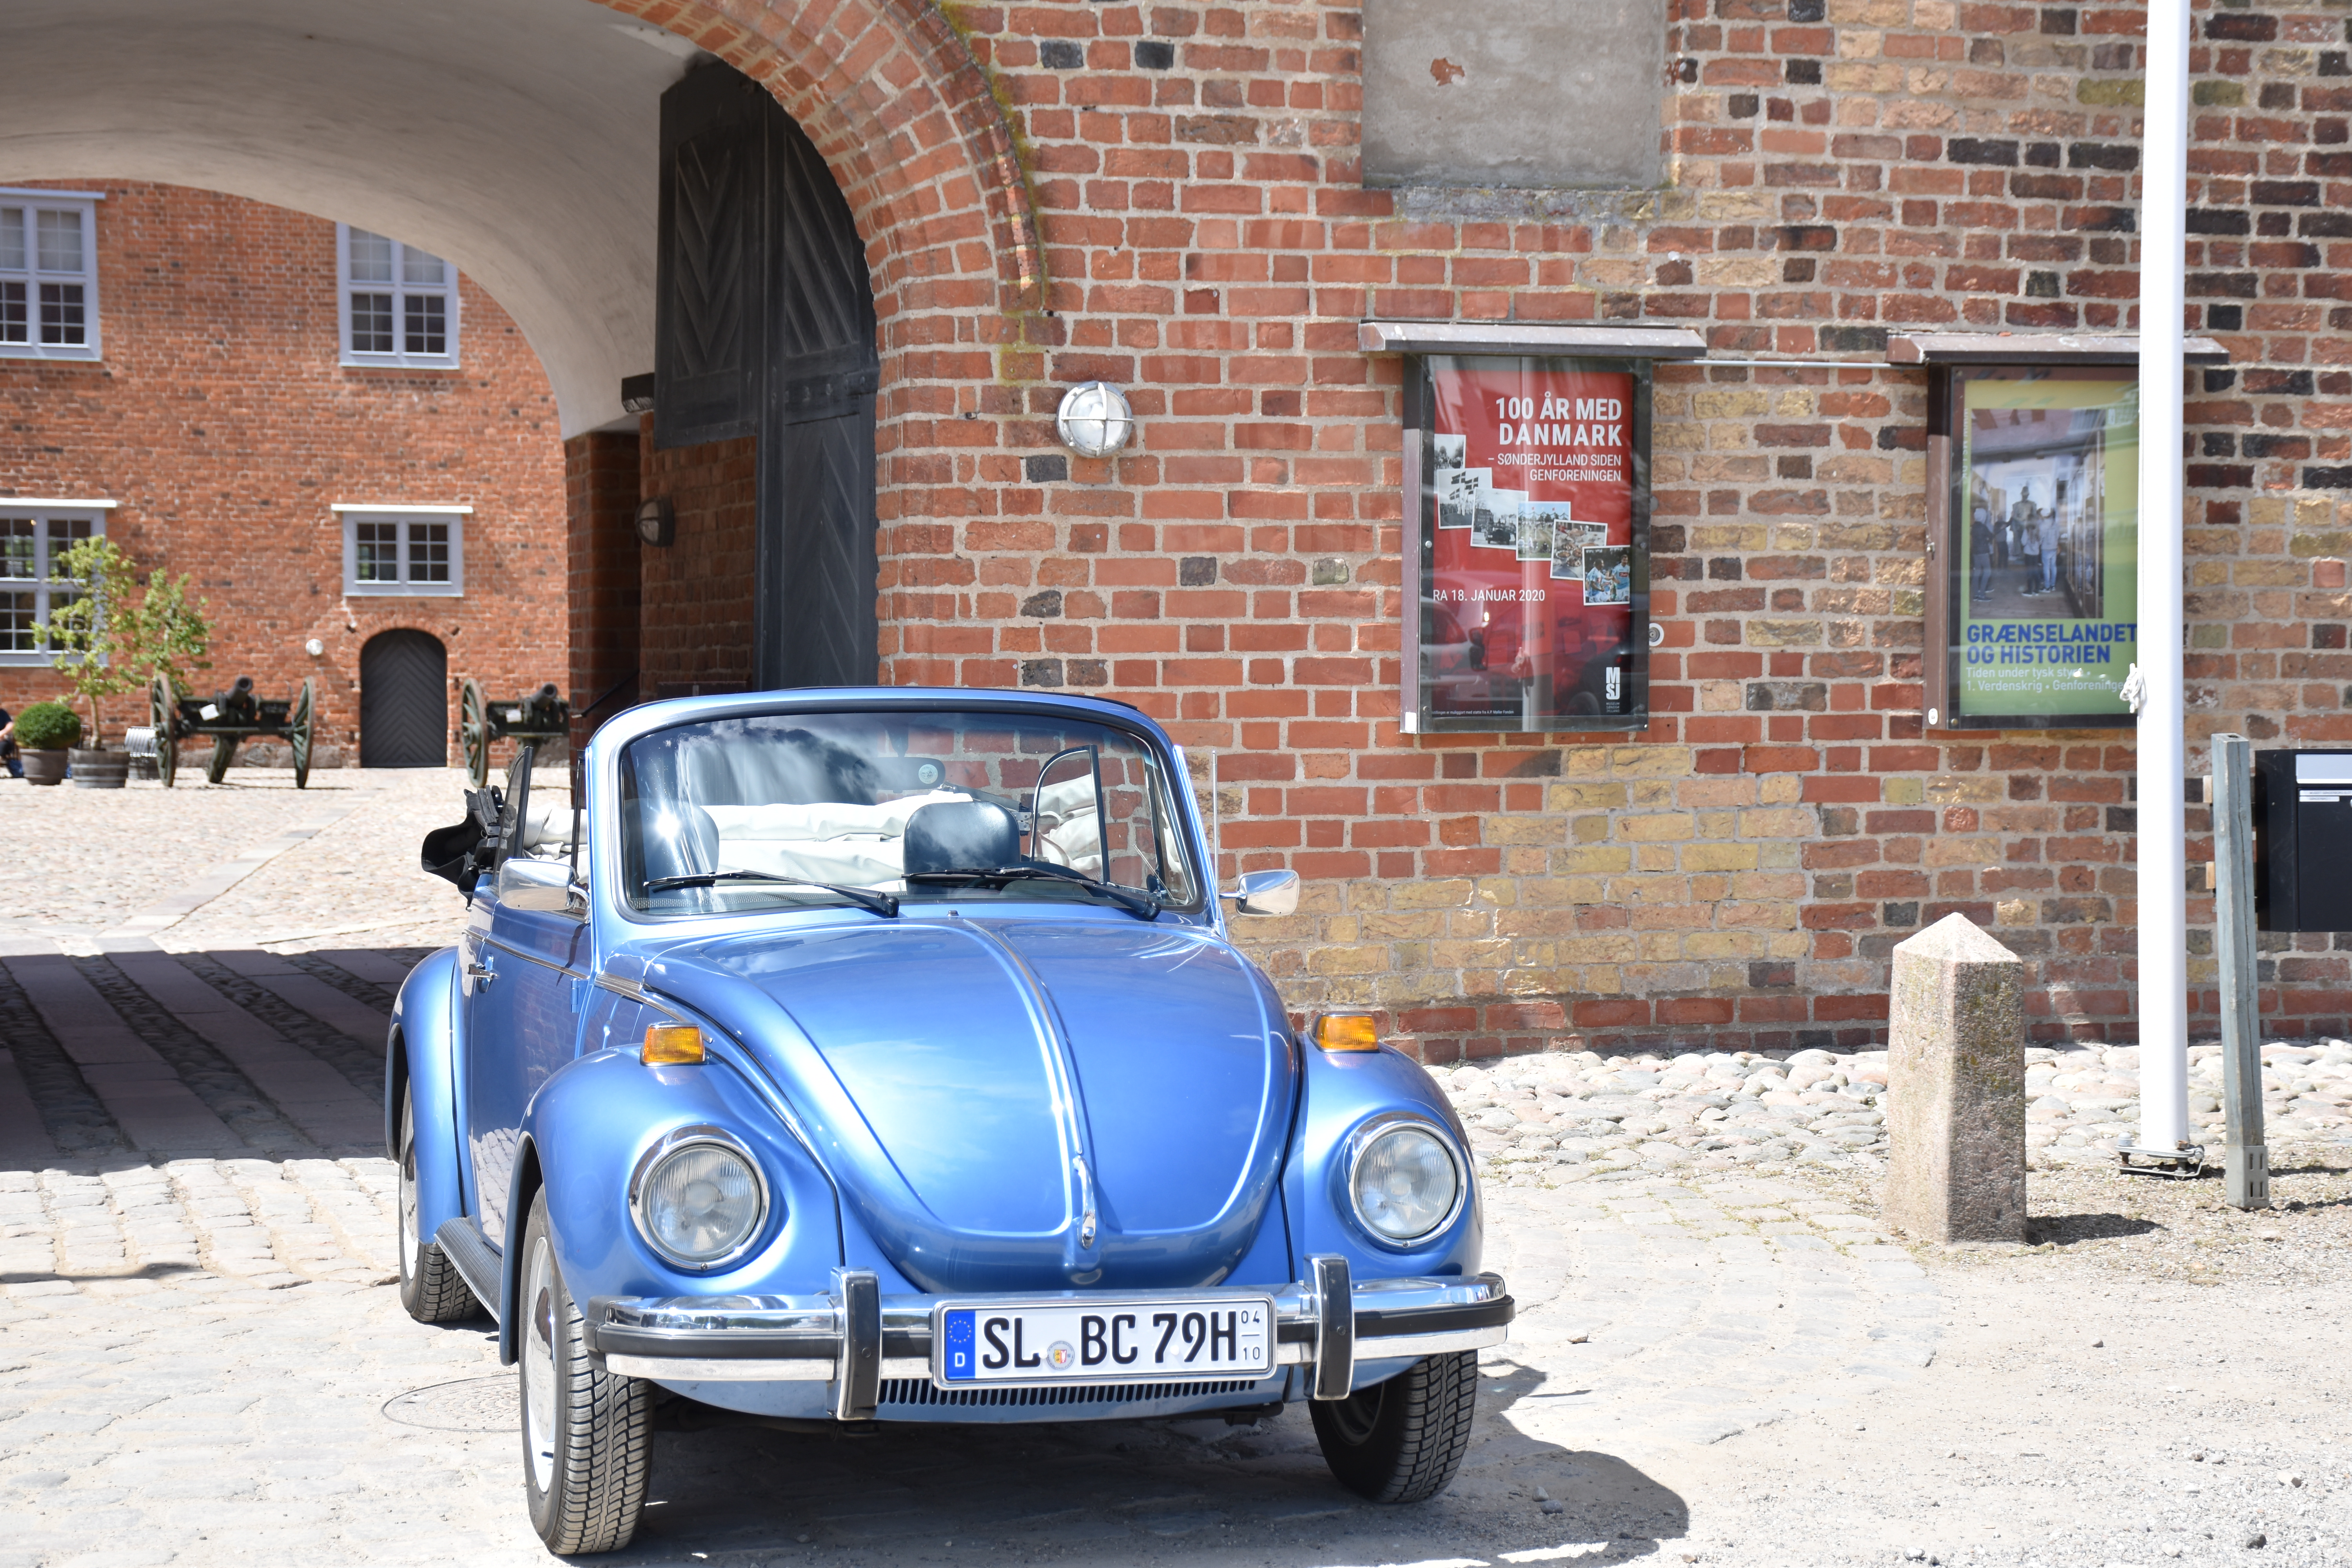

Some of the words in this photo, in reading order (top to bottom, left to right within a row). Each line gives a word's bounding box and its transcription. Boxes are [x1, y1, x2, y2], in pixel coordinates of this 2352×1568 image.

[1496, 397, 1534, 419] 100
[1539, 391, 1570, 420] ÅR
[1576, 398, 1622, 420] MED
[1499, 423, 1622, 446] DANMARK
[1497, 453, 1588, 466] SØNDERJYLLAND
[1590, 454, 1621, 466] SIDEN
[1530, 469, 1621, 481] GENFORENINGEN
[1433, 589, 1448, 601] RA
[1452, 589, 1467, 601] 18.
[1471, 589, 1516, 601] JANUAR
[1519, 589, 1545, 601] 2020
[1967, 624, 2137, 642] GRÆNSELANDET
[1967, 645, 1994, 664] OG
[2001, 644, 2111, 663] HISTORIEN
[1966, 667, 1995, 677] Tiden
[1998, 667, 2029, 677] under
[2033, 667, 2054, 679] tysk
[1966, 681, 1975, 691] 1.
[1978, 680, 2042, 693] Verdenskrig
[2053, 680, 2124, 692] Genforeninge
[1241, 1310, 1260, 1324] 04
[982, 1316, 1041, 1370] SL
[1081, 1314, 1138, 1367] BC
[1152, 1310, 1237, 1365] 79H
[955, 1352, 965, 1367] D
[1243, 1347, 1260, 1360] 10
